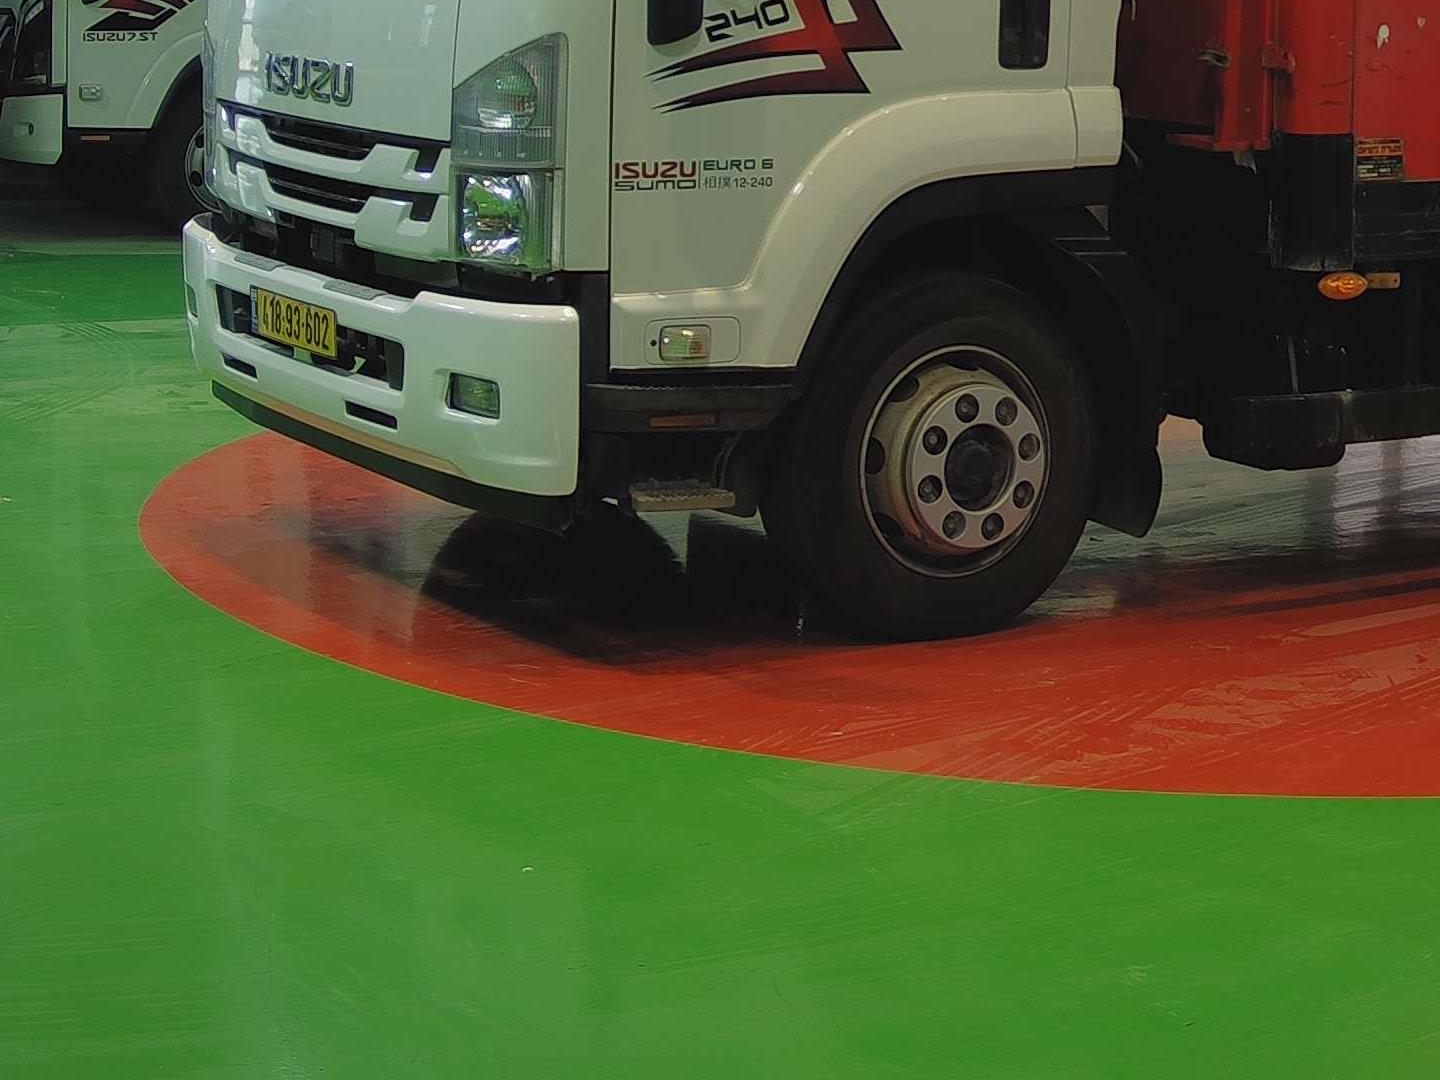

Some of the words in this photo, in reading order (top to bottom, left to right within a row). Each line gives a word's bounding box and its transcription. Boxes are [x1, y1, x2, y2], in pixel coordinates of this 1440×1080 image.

[263, 49, 354, 107] ISUZU
[615, 160, 697, 179] ISUZU
[703, 158, 756, 172] EURO
[761, 158, 774, 170] 6
